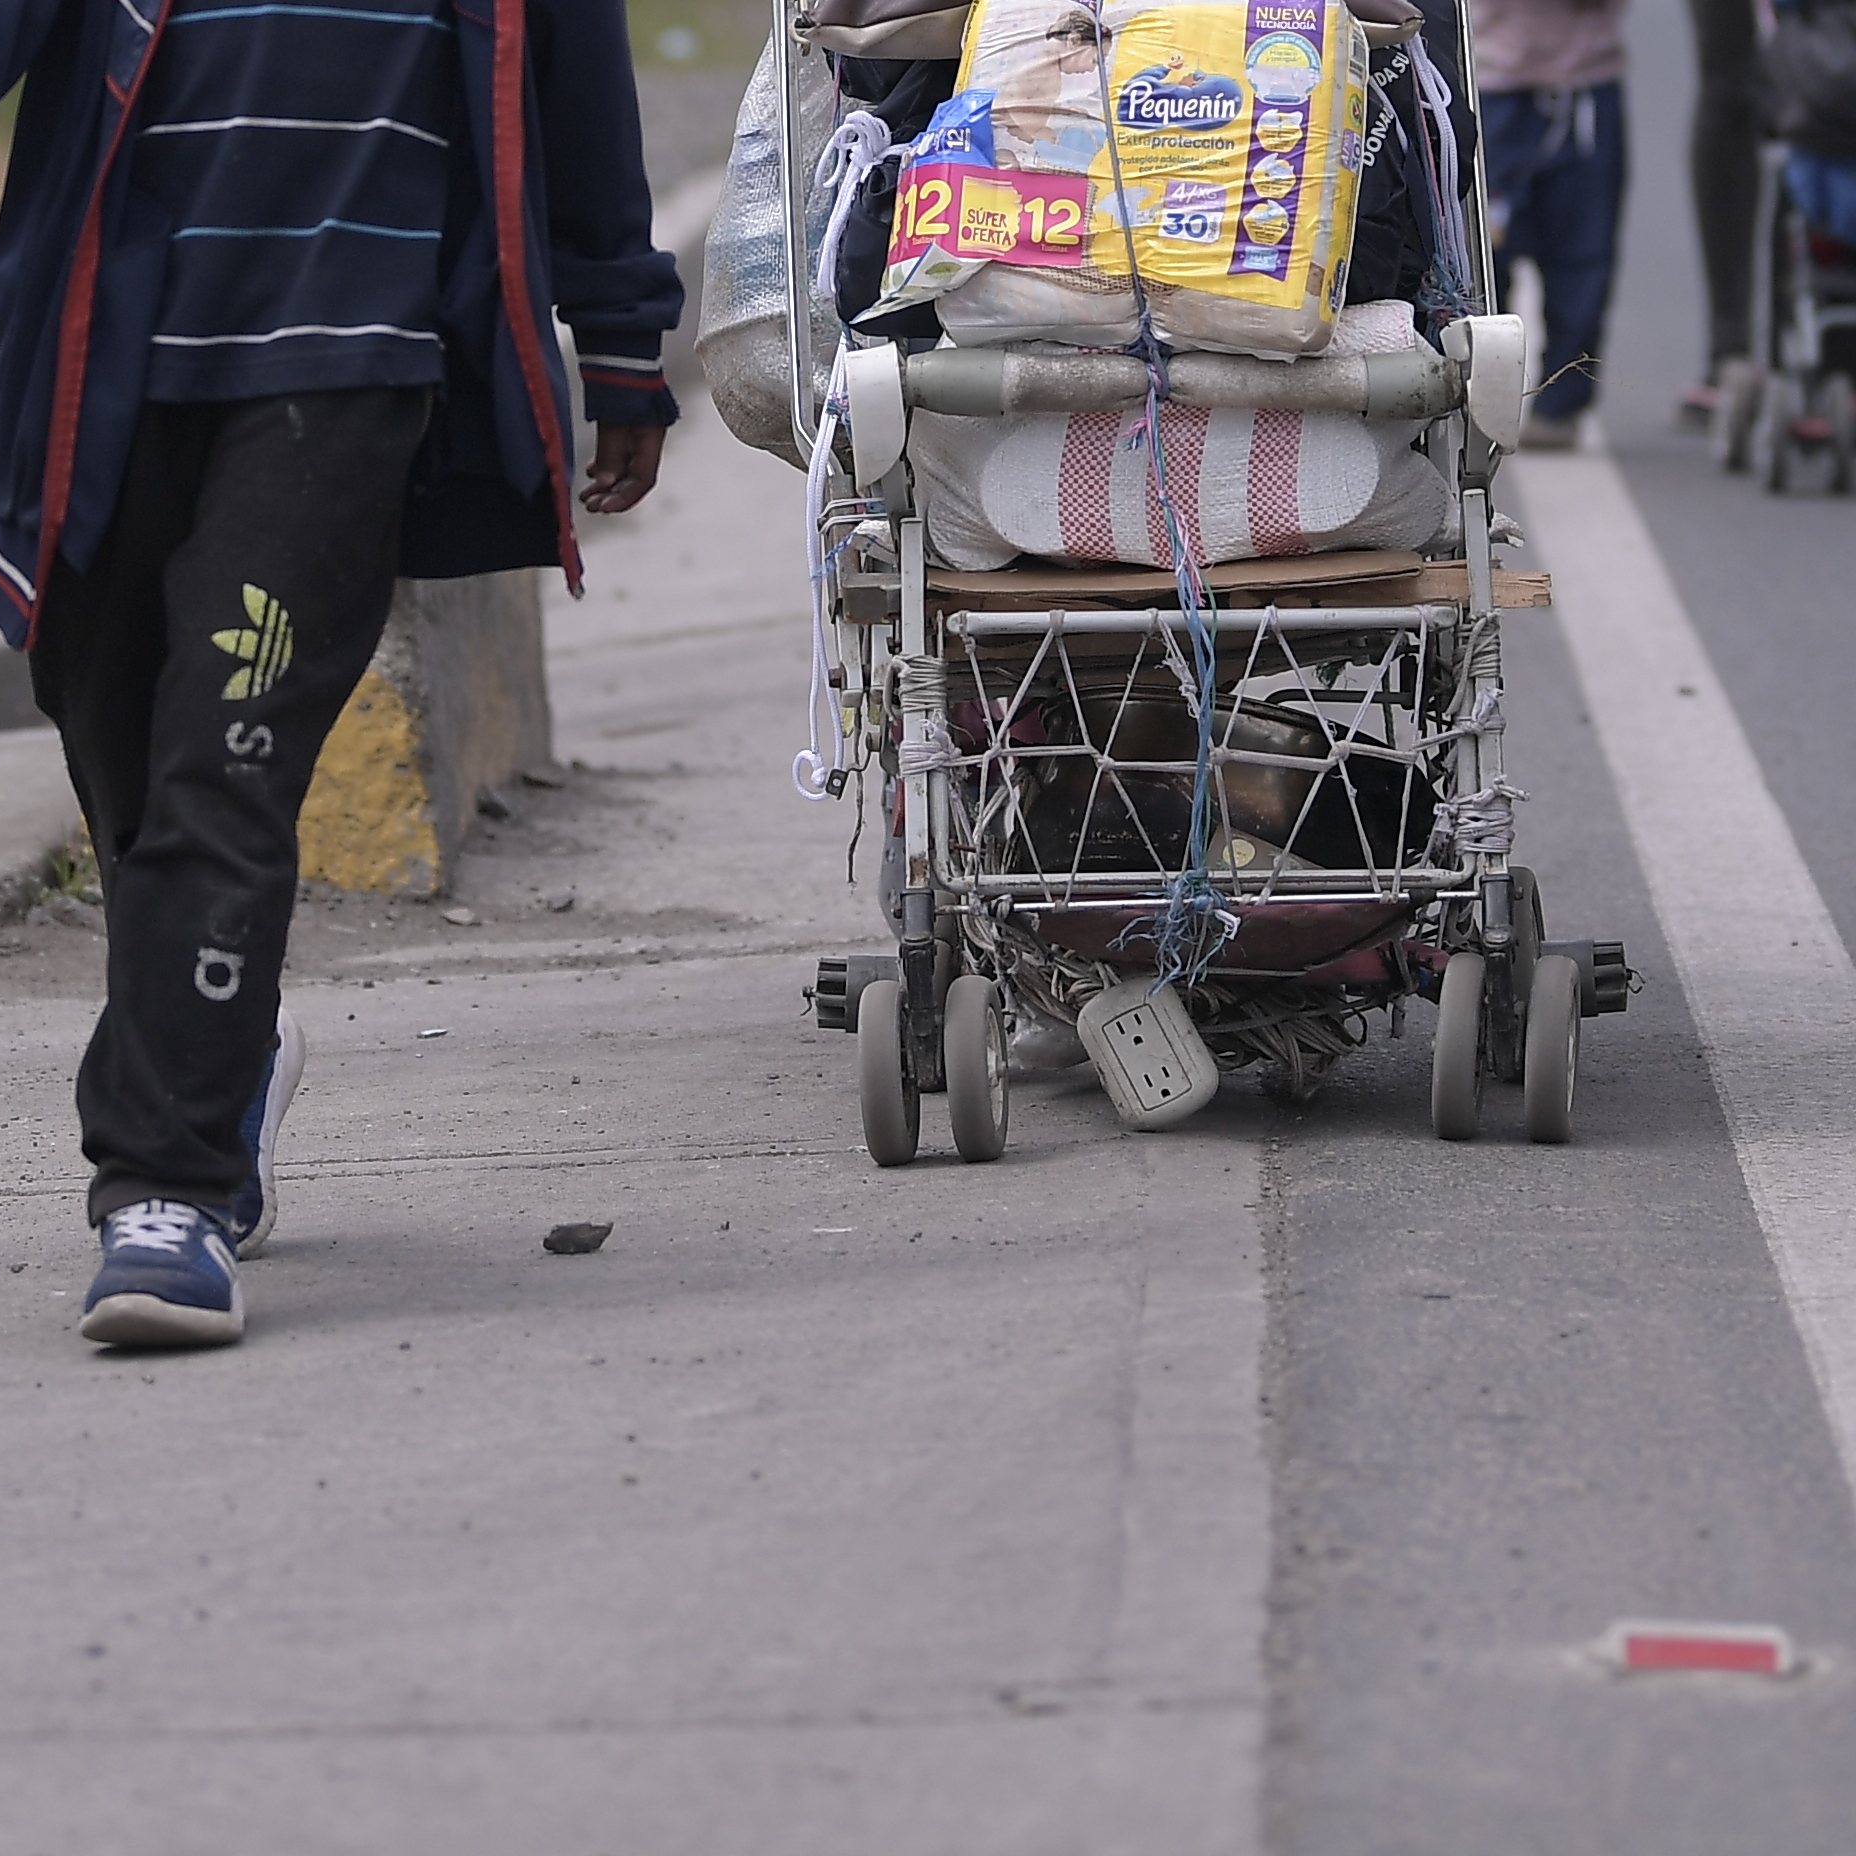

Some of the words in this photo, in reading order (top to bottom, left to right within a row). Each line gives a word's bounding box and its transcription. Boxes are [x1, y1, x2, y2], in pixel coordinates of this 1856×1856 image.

[1255, 6, 1317, 23] NUEVA
[1255, 19, 1317, 31] TECNOLOGÍA
[1121, 80, 1236, 125] Pequeñín
[904, 179, 953, 239] 12
[967, 207, 1008, 228] SÚPER
[1023, 197, 1082, 244] 12
[961, 225, 1012, 246] OFERTA
[1162, 213, 1208, 239] 30
